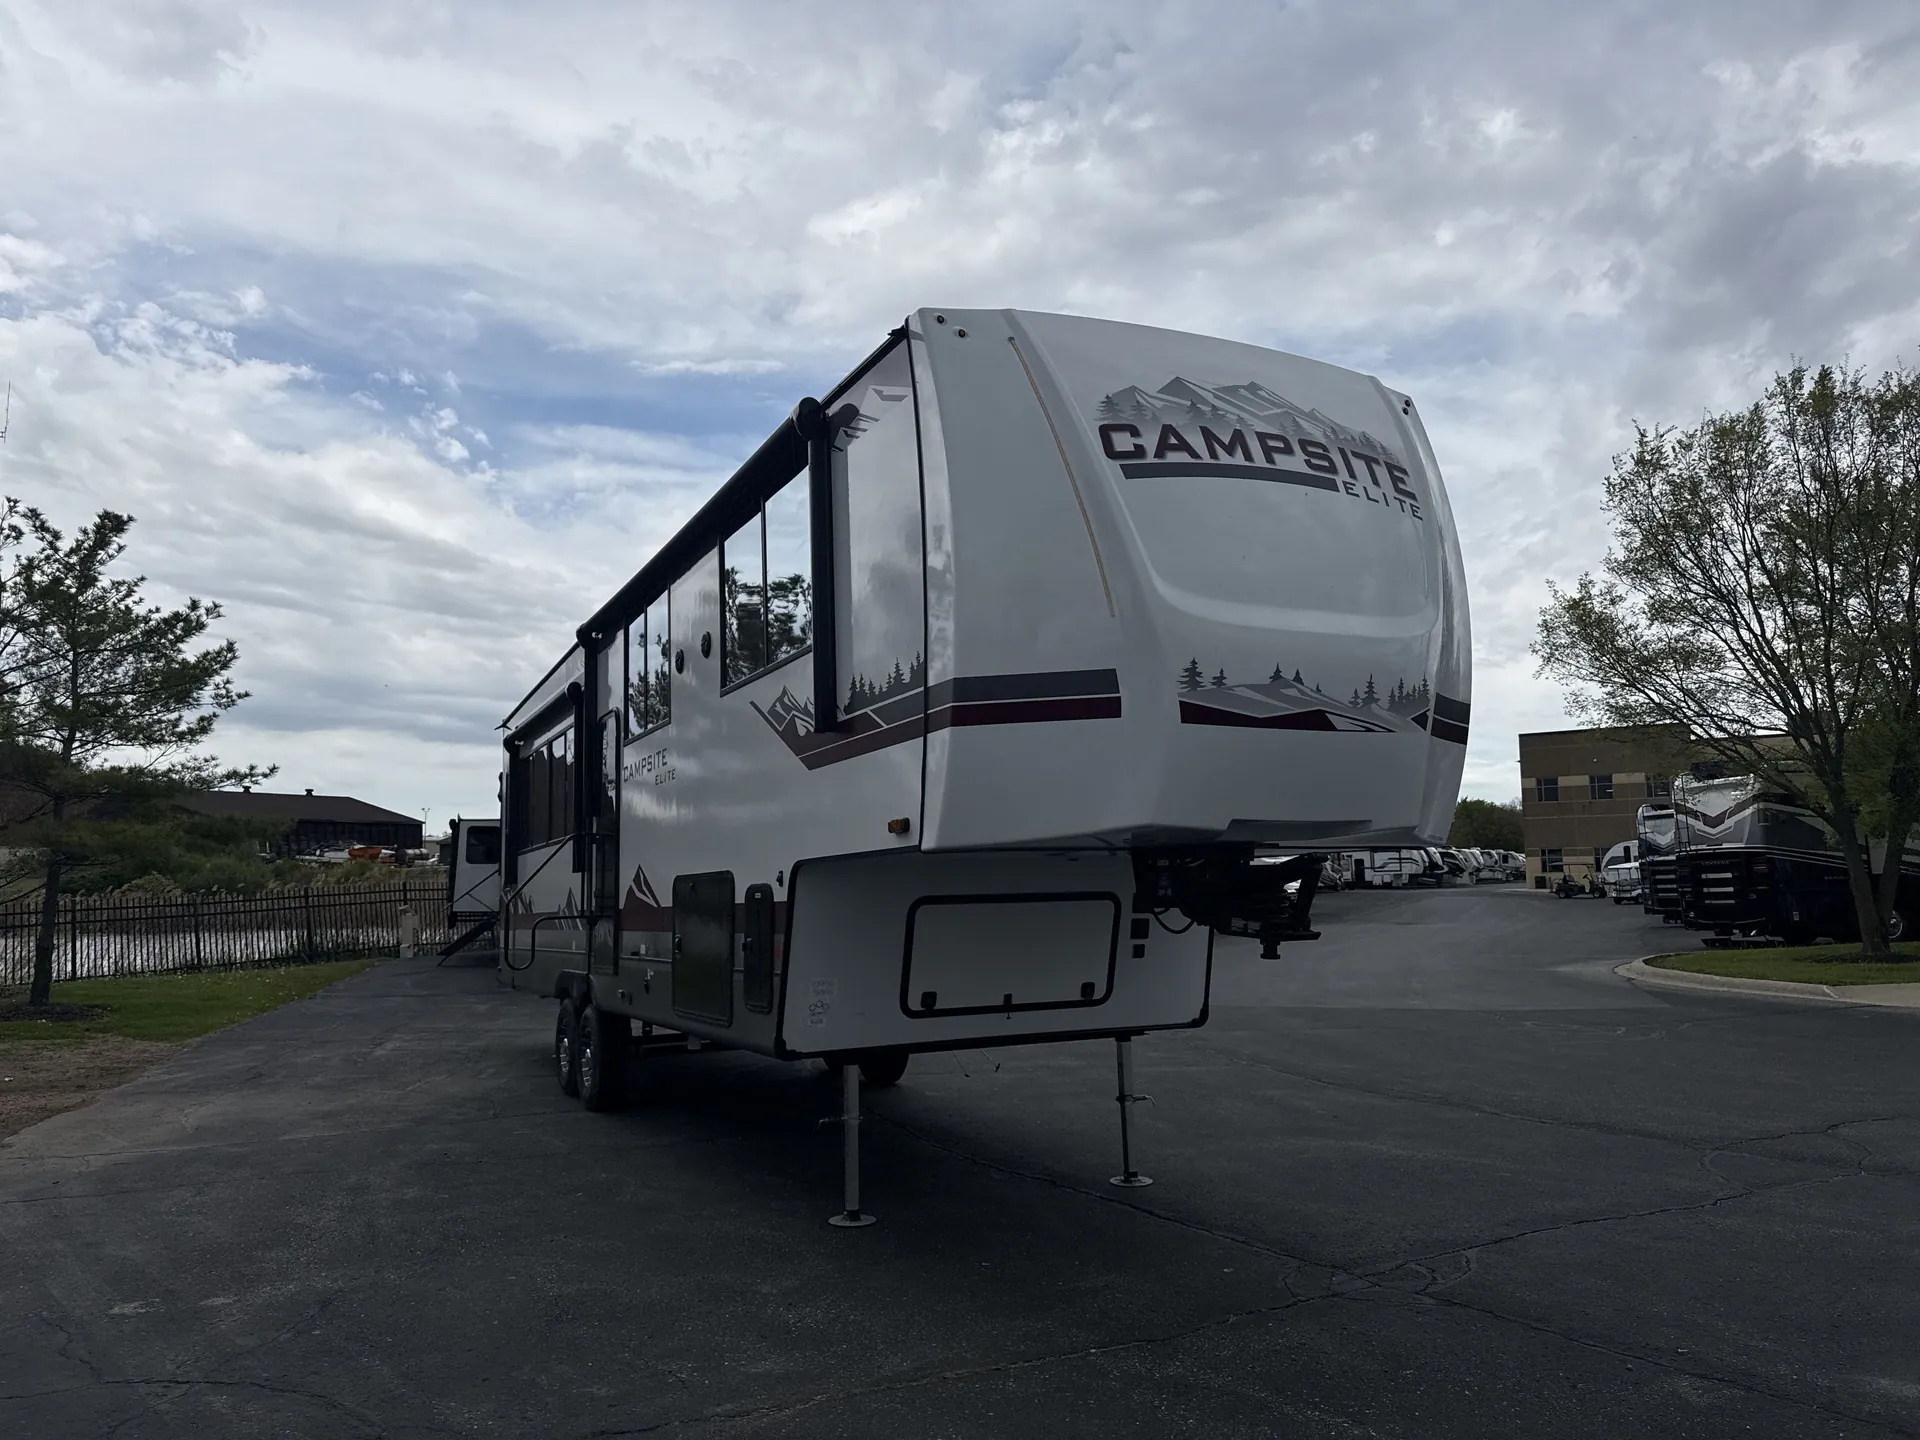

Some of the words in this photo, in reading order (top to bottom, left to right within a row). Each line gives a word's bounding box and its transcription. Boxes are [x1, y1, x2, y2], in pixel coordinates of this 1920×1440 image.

[1098, 423, 1418, 502] CAMPSITE
[1342, 480, 1423, 521] ELITE
[623, 747, 668, 783] CAMPSITE
[655, 768, 676, 786] ELITE
